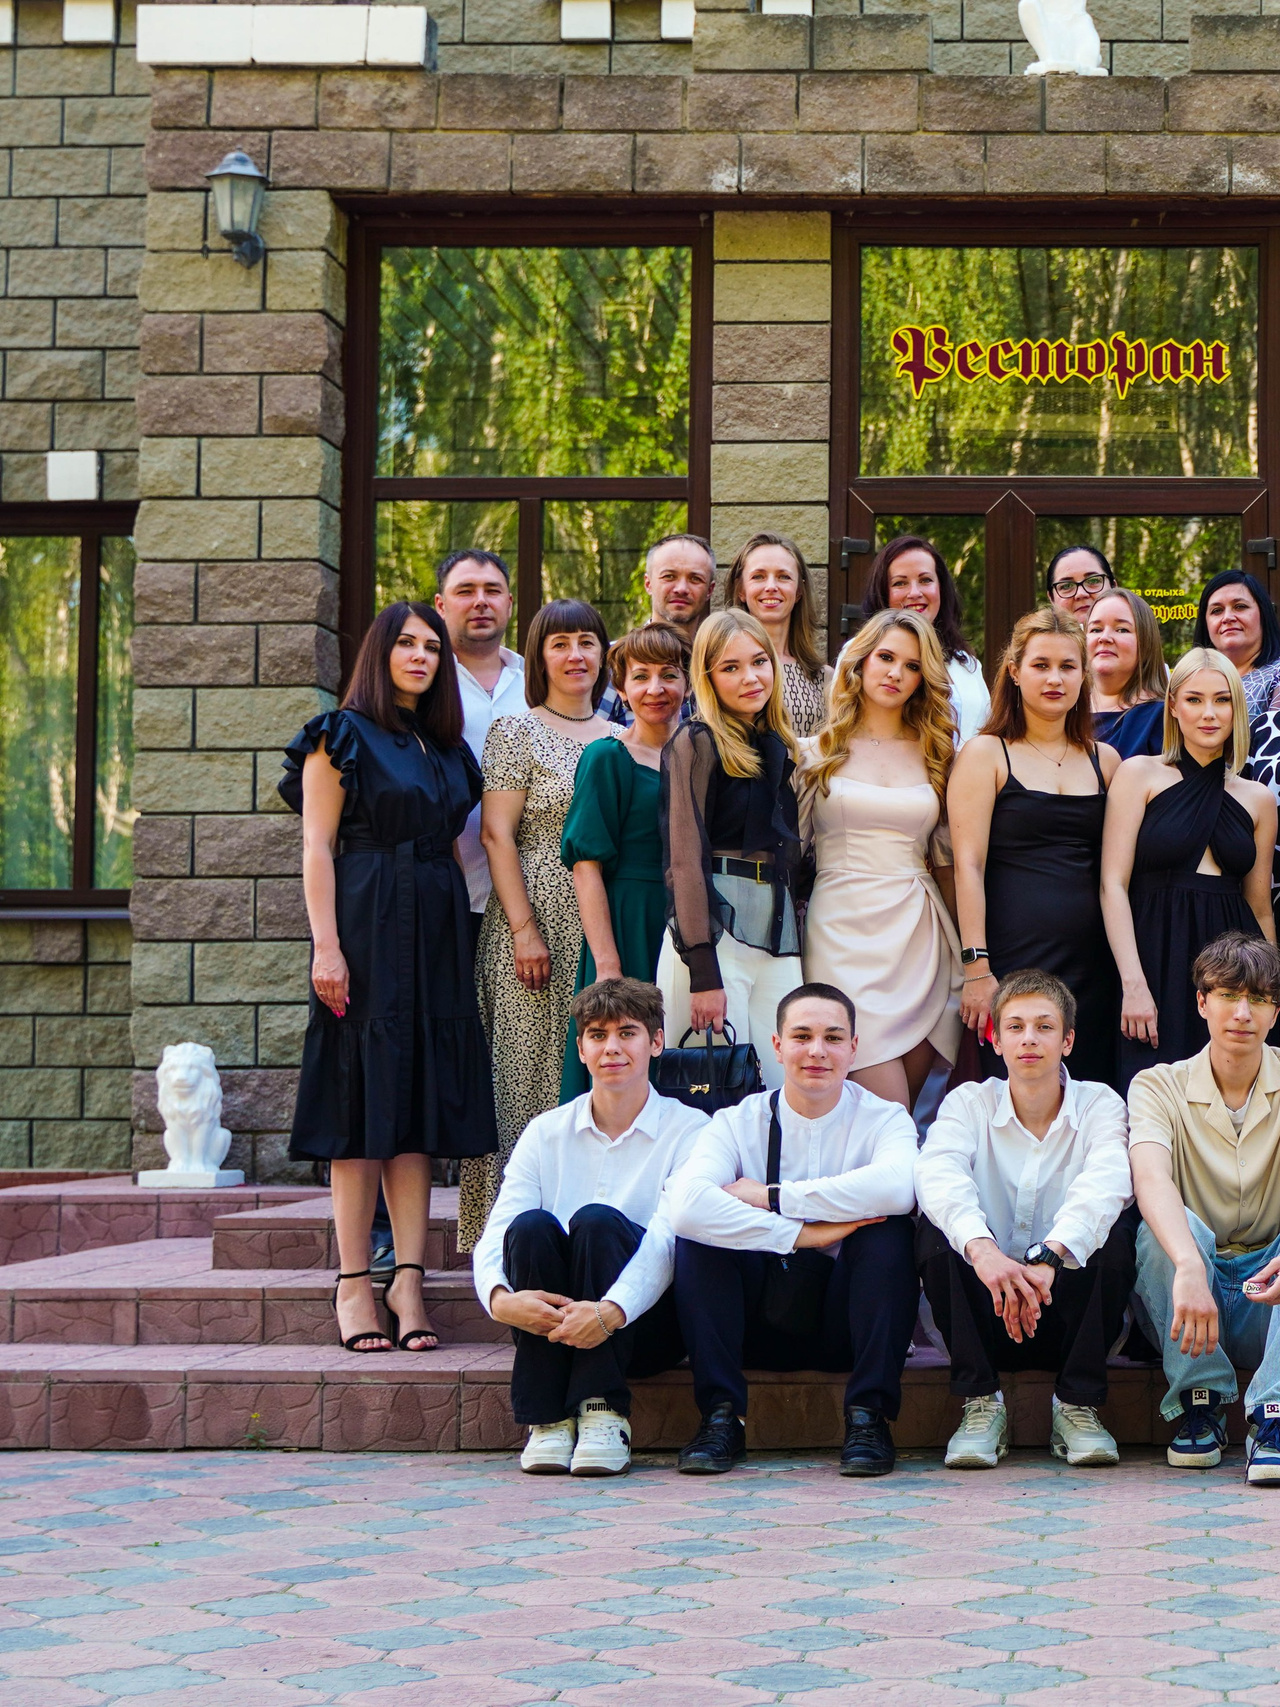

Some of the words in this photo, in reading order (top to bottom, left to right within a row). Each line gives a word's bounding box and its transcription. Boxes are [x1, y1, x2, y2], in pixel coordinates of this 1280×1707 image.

[891, 324, 1231, 400] Ресторан
[1144, 588, 1185, 598] отдыха
[586, 1402, 612, 1412] PUMA
